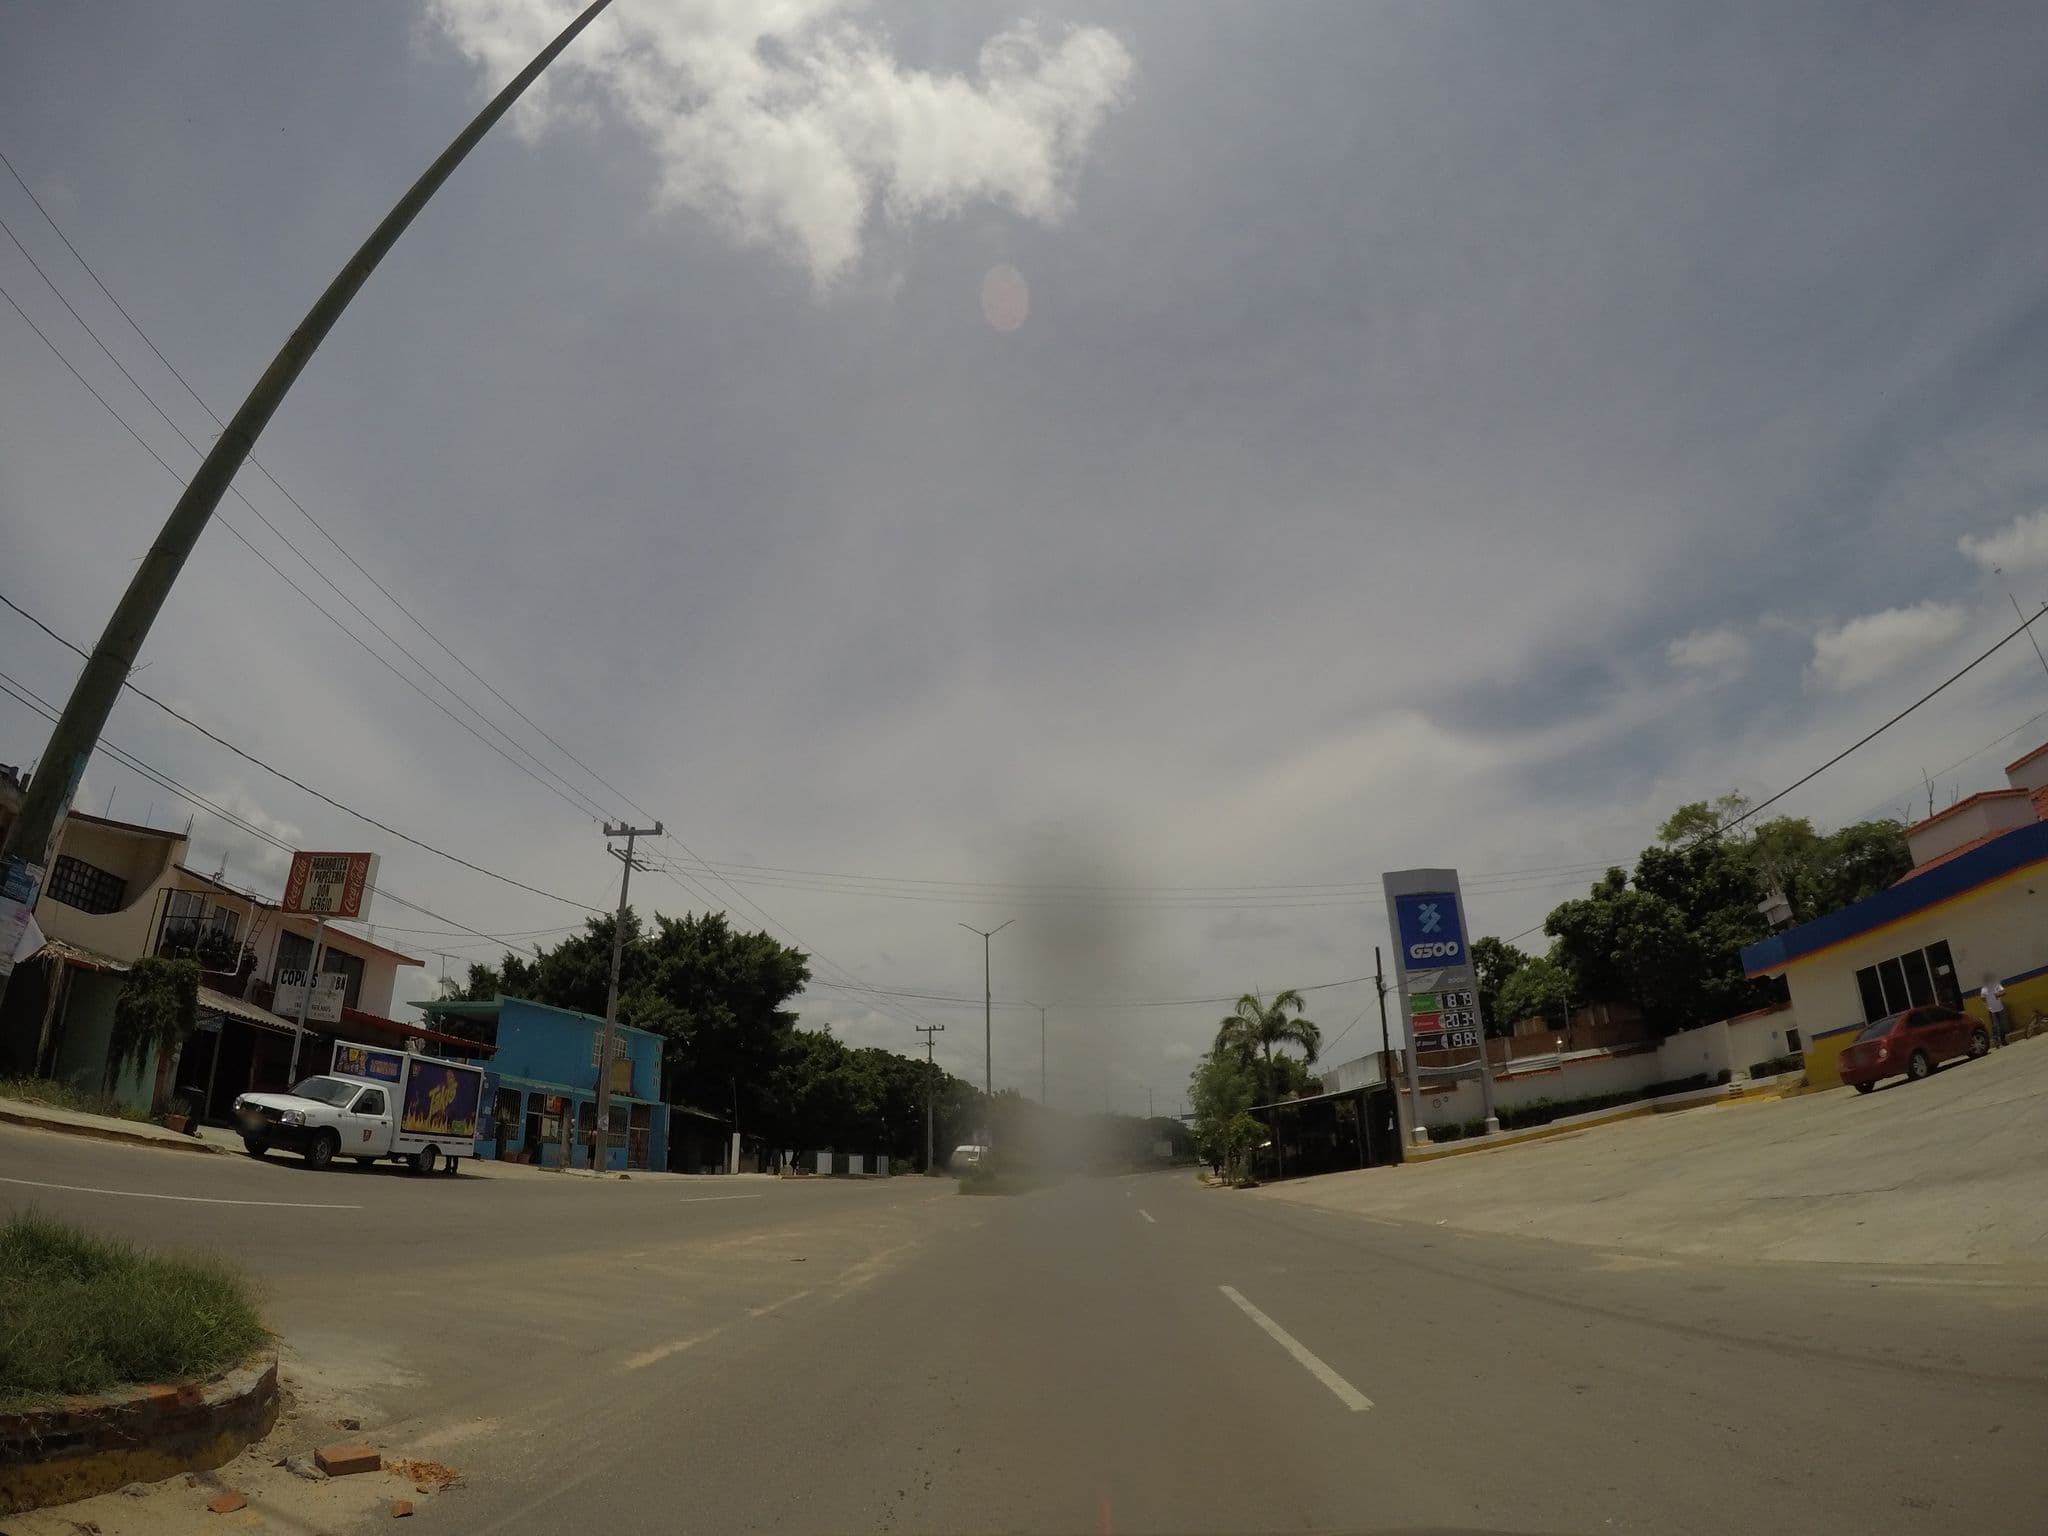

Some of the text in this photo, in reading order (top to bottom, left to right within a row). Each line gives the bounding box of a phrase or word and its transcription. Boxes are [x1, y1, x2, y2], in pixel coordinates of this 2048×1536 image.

[312, 857, 348, 871] ABARROTES
[316, 885, 330, 898] DON
[309, 897, 332, 912] SERGIO
[1410, 941, 1459, 959] G500
